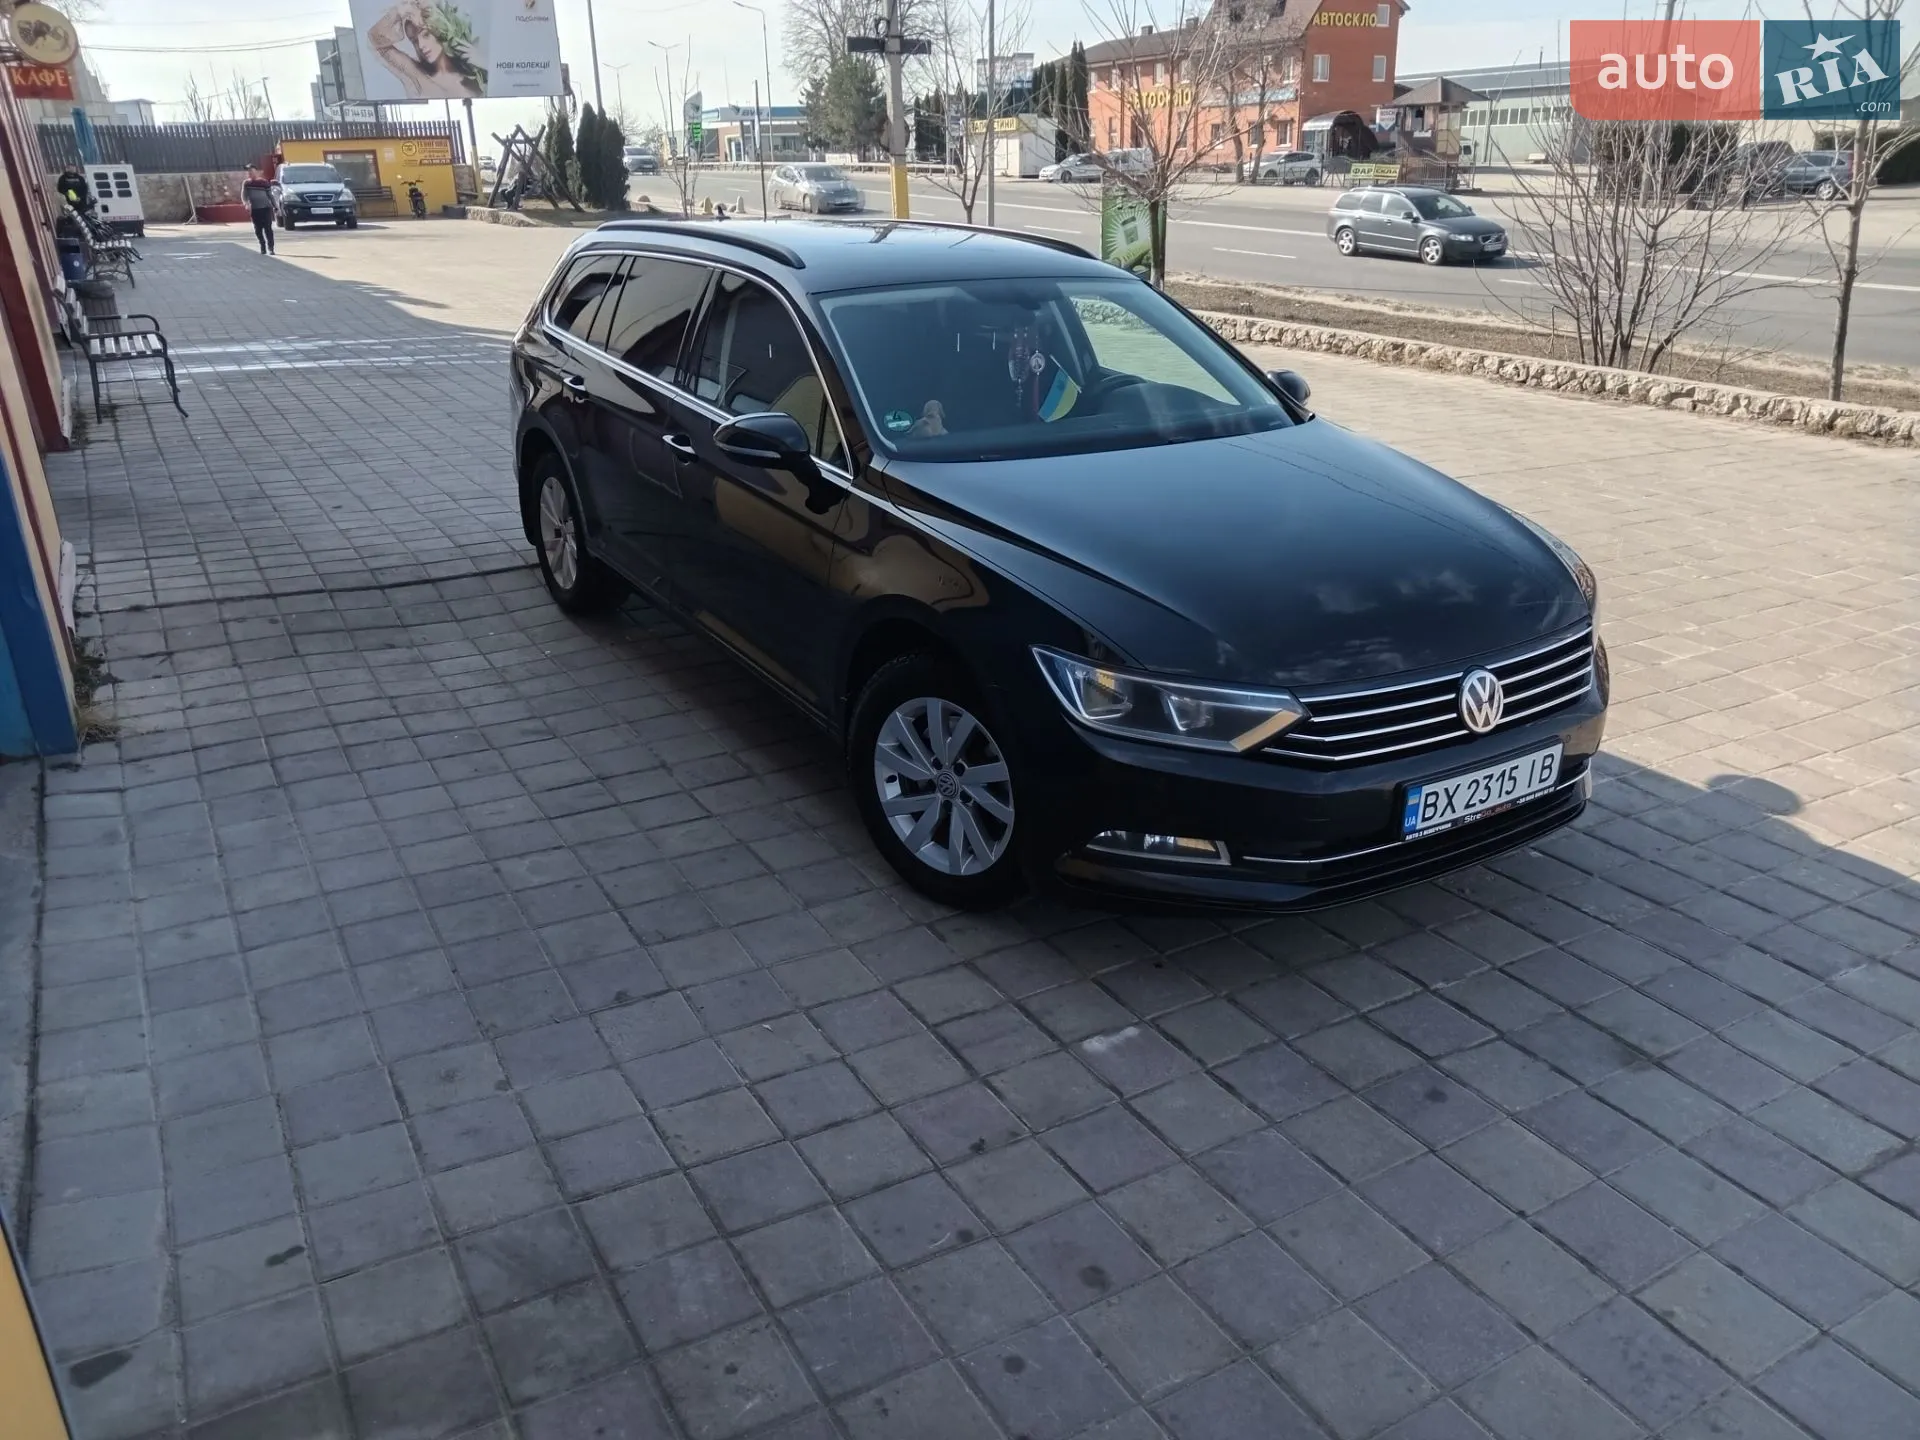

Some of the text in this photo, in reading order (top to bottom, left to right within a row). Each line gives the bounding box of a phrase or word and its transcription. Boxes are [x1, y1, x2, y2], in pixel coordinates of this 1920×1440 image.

[1312, 12, 1377, 27] АВТОСКЛО
[496, 60, 551, 69] НОВІ КОЛЕКЦІЇ
[11, 67, 68, 87] КАФЕ
[1352, 166, 1373, 175] ФАР
[1421, 753, 1555, 823] BX 2315 IB
[1405, 815, 1416, 827] UA
